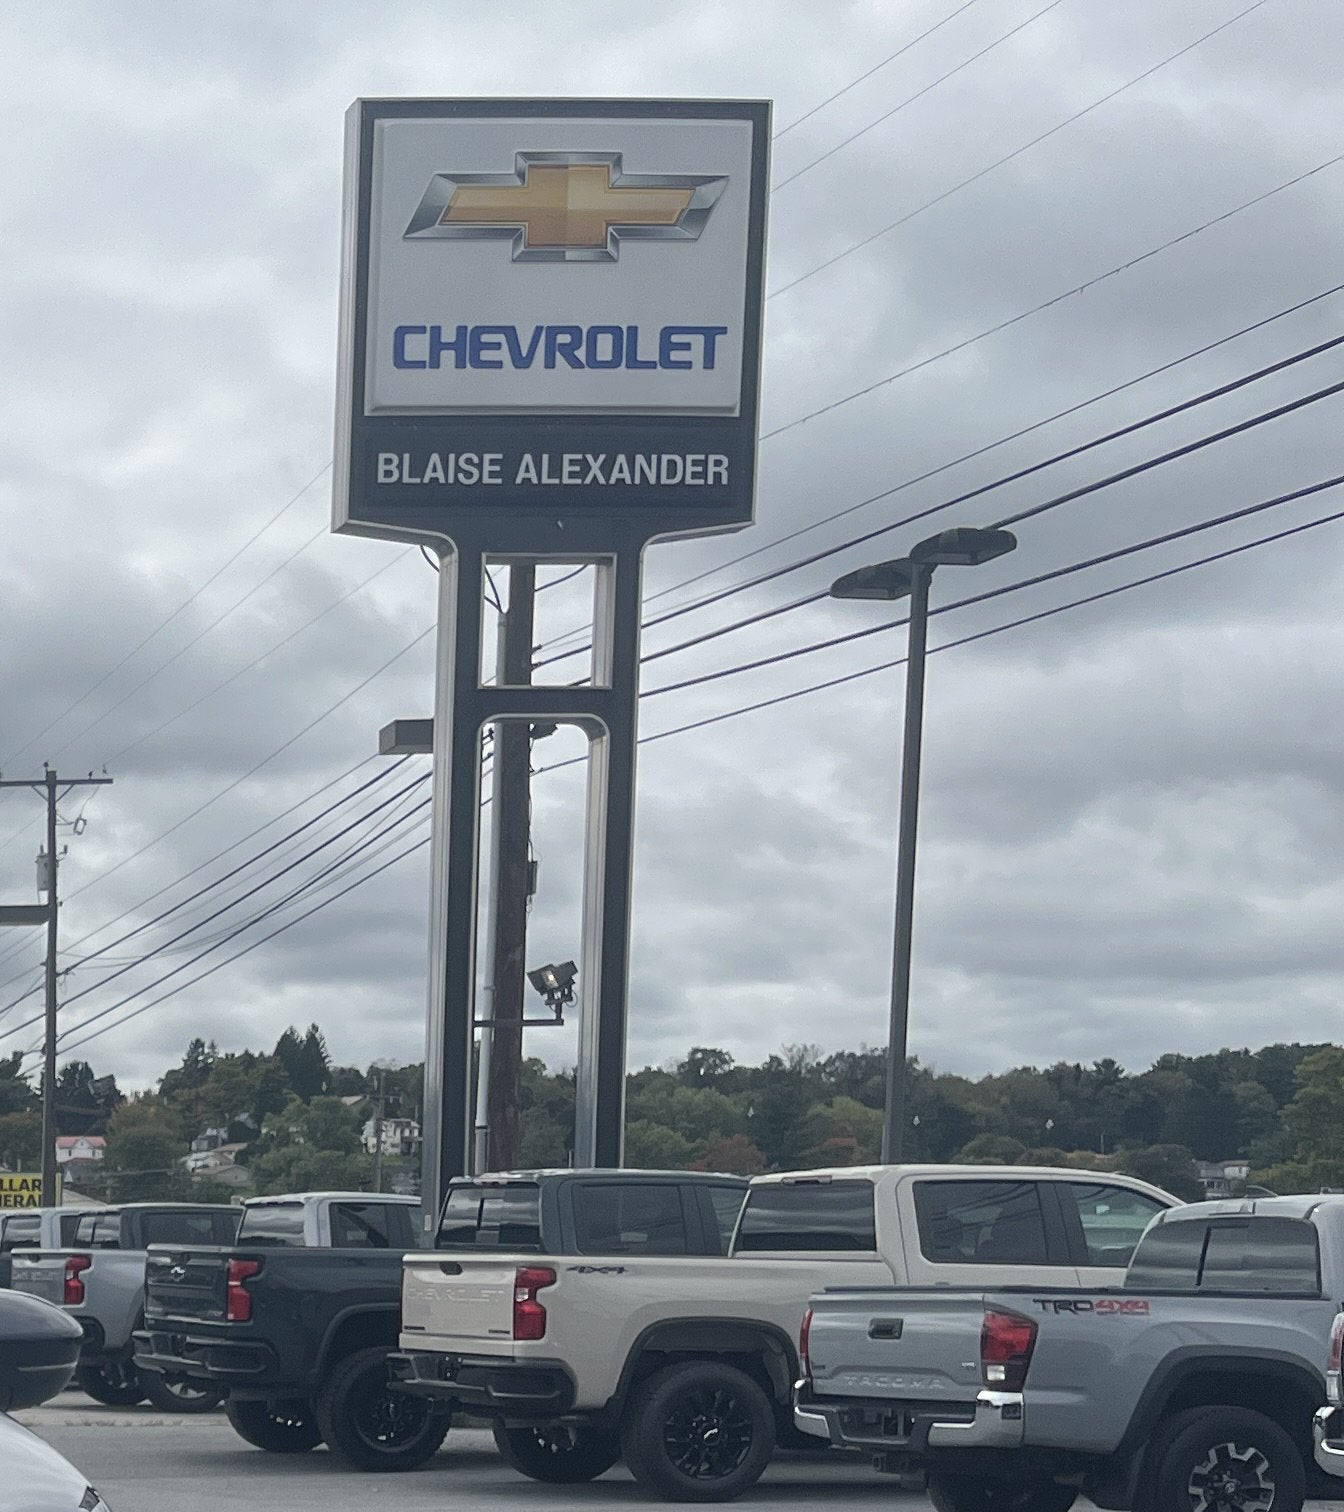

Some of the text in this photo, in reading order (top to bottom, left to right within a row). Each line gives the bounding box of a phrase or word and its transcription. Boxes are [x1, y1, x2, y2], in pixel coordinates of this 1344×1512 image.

[392, 325, 728, 370] CHEVROLET
[376, 452, 730, 486] BLAISE ALEXANDER
